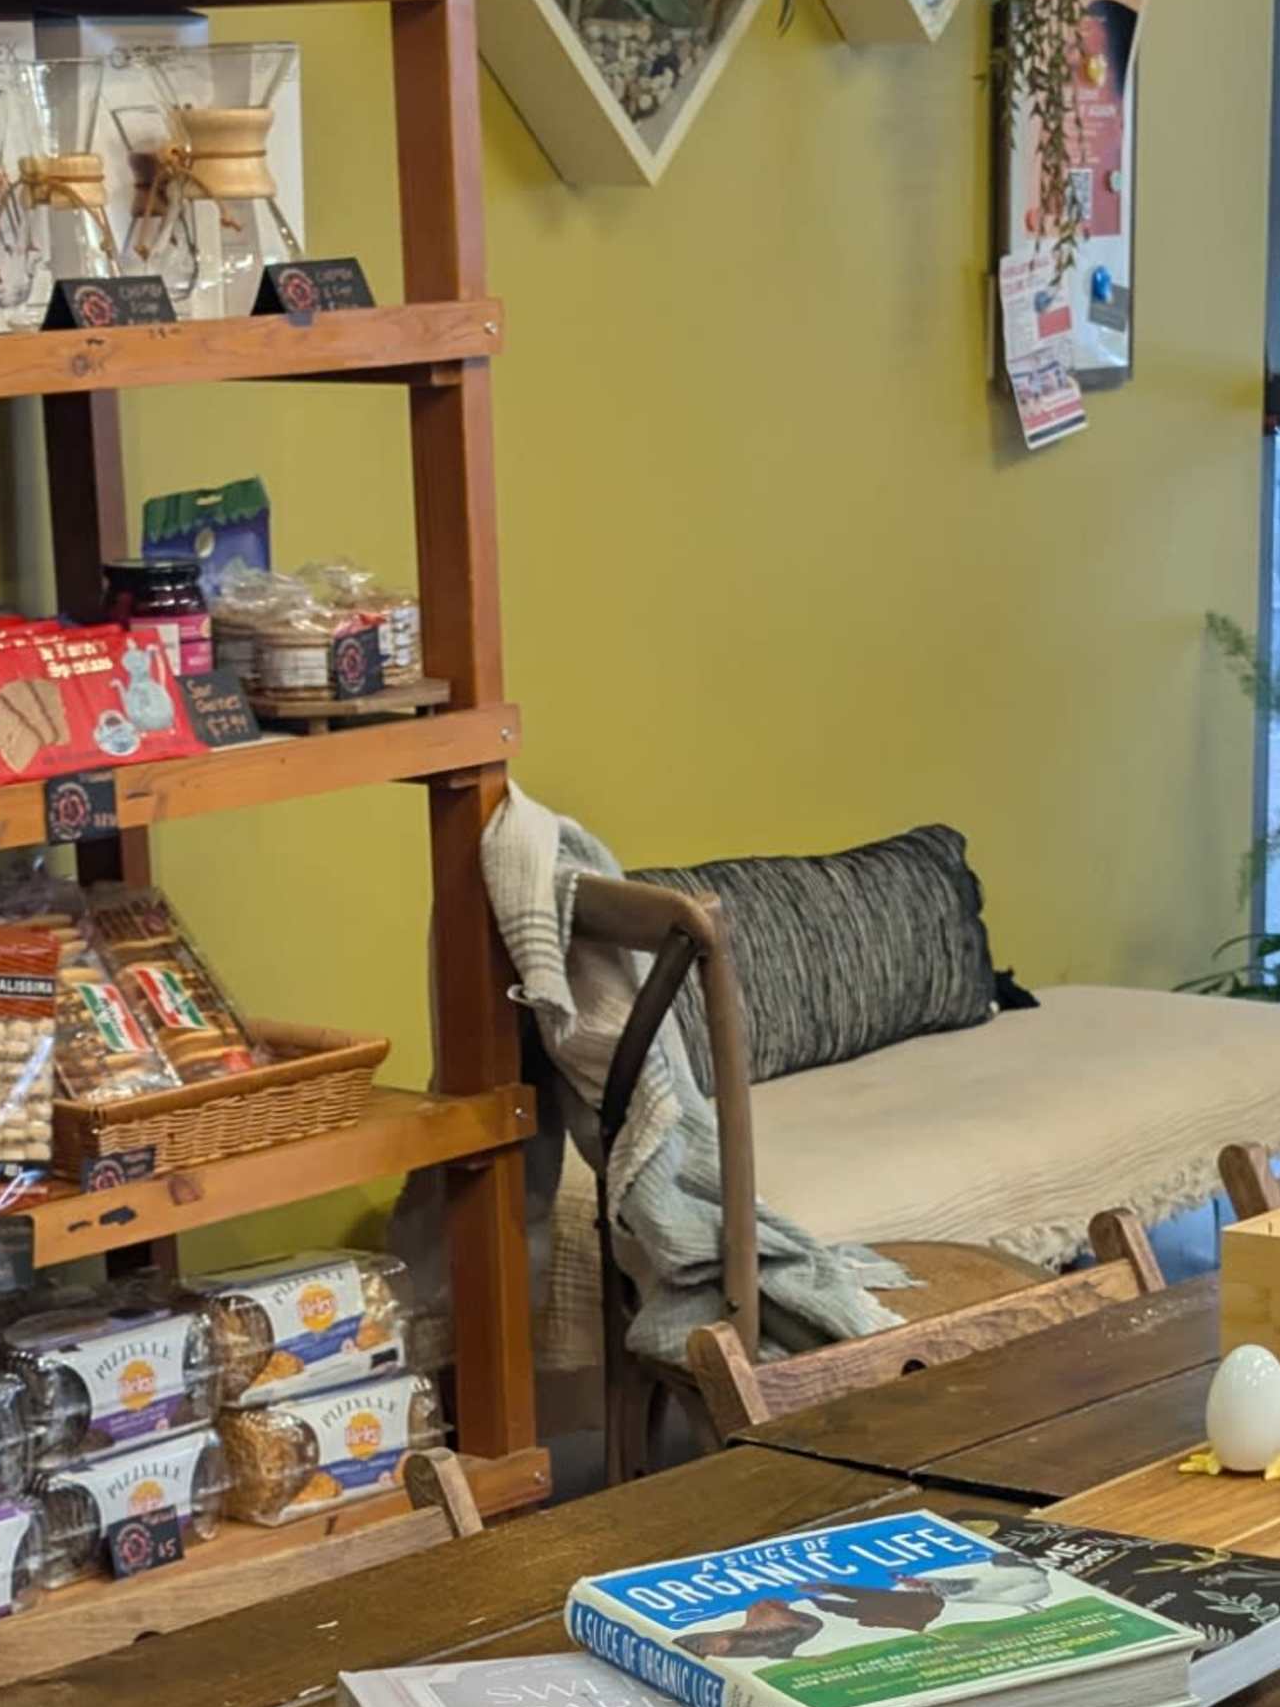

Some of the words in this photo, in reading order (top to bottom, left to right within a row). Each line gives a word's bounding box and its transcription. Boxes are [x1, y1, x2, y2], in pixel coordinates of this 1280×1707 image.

[321, 1396, 397, 1429] PIZZELLE
[625, 1552, 859, 1611] ORGANIC
[850, 1527, 975, 1569] LIFE
[702, 1559, 720, 1574] A
[723, 1544, 794, 1569] SLICE
[802, 1536, 832, 1557] OF
[576, 1606, 584, 1644] A
[585, 1611, 621, 1663] SLICE
[621, 1633, 640, 1672] OF
[638, 1642, 692, 1704] ORGANIC
